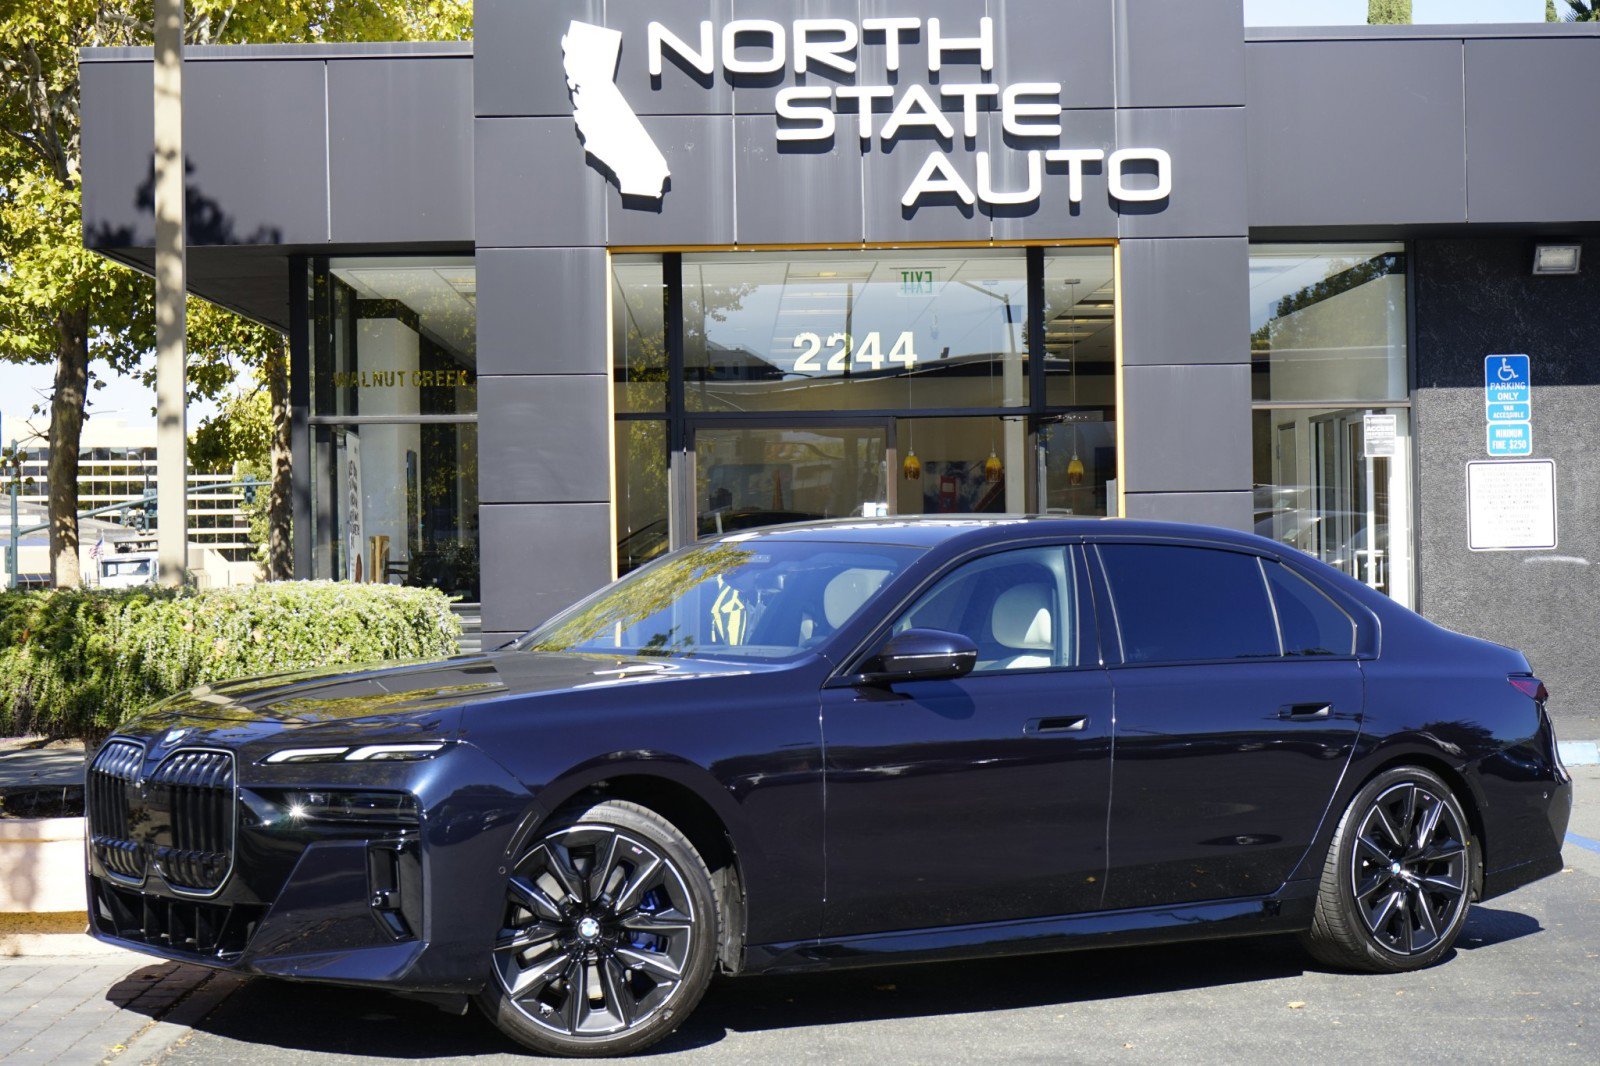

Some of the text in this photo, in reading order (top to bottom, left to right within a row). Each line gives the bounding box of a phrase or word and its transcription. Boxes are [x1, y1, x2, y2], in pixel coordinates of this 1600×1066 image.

[647, 16, 994, 77] NORTH
[775, 82, 1062, 141] STATE
[901, 147, 1172, 207] AUTO
[793, 331, 918, 372] 2244
[333, 369, 468, 388] WALNUT CREEK
[1489, 381, 1526, 391] PARKING
[1497, 392, 1520, 401] ONLY
[1495, 428, 1523, 438] MINIMUM
[1492, 439, 1527, 450] FINE $250
